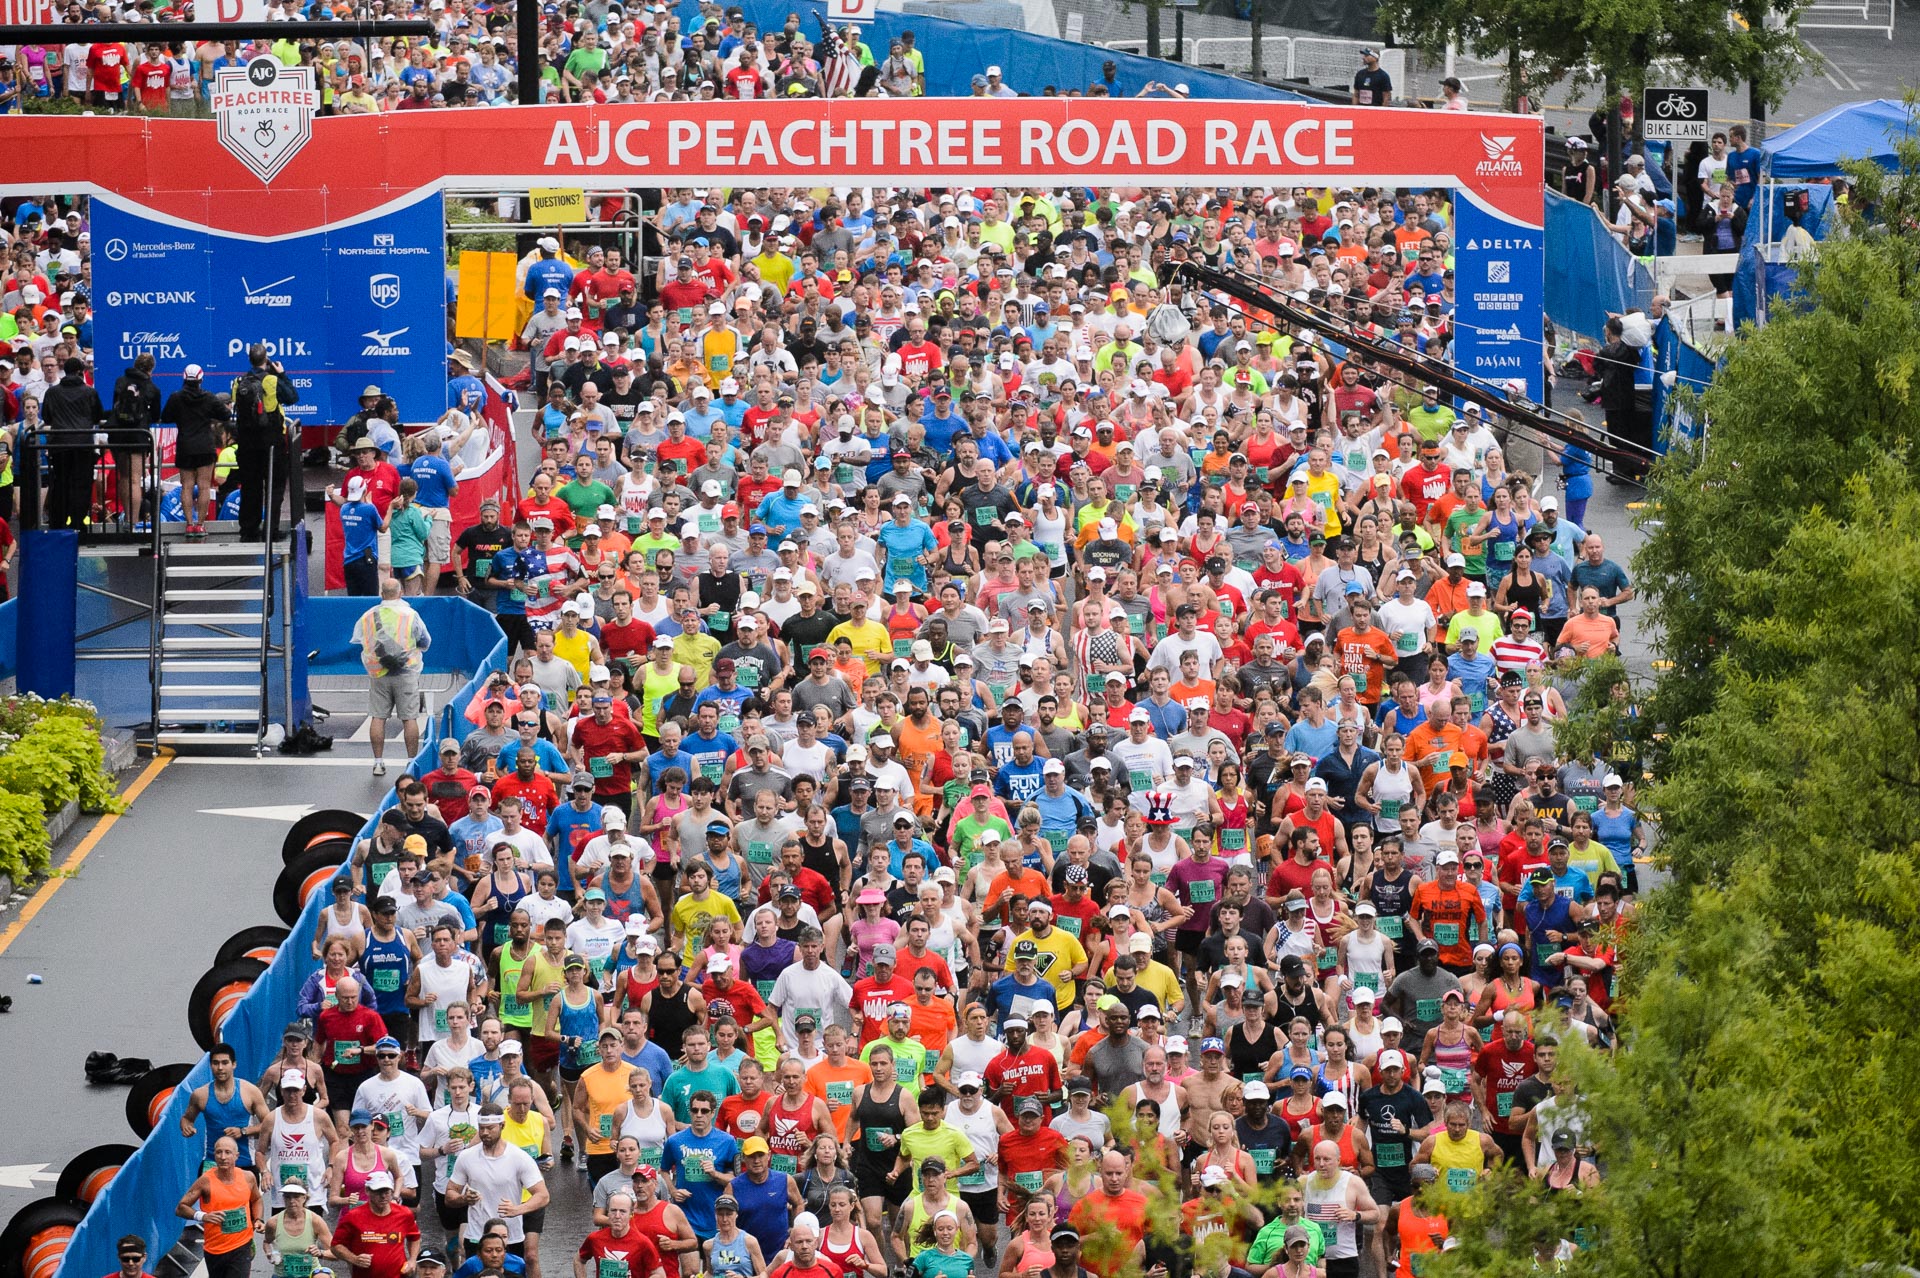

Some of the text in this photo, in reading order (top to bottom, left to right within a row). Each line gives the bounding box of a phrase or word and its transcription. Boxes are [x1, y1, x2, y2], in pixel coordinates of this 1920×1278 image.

[251, 67, 273, 81] AJC
[213, 89, 314, 109] PEACHTREE
[1646, 123, 1705, 136] BIKE LANE
[543, 119, 1355, 166] AJC PEACHTREE ROAD RACE
[1475, 161, 1523, 171] ATLANTA
[533, 193, 580, 210] QUESTIONS?
[132, 241, 195, 252] Mercedes-Benz
[1483, 239, 1532, 249] DELTA
[1488, 262, 1507, 282] HOME
[124, 292, 195, 305] PNC BANK
[245, 293, 292, 307] verizon
[373, 284, 398, 303] ups
[131, 331, 180, 344] Michelob
[1475, 354, 1520, 368] DASANI
[1009, 778, 1039, 790] RUN
[1003, 1064, 1044, 1081] WOLFPACK
